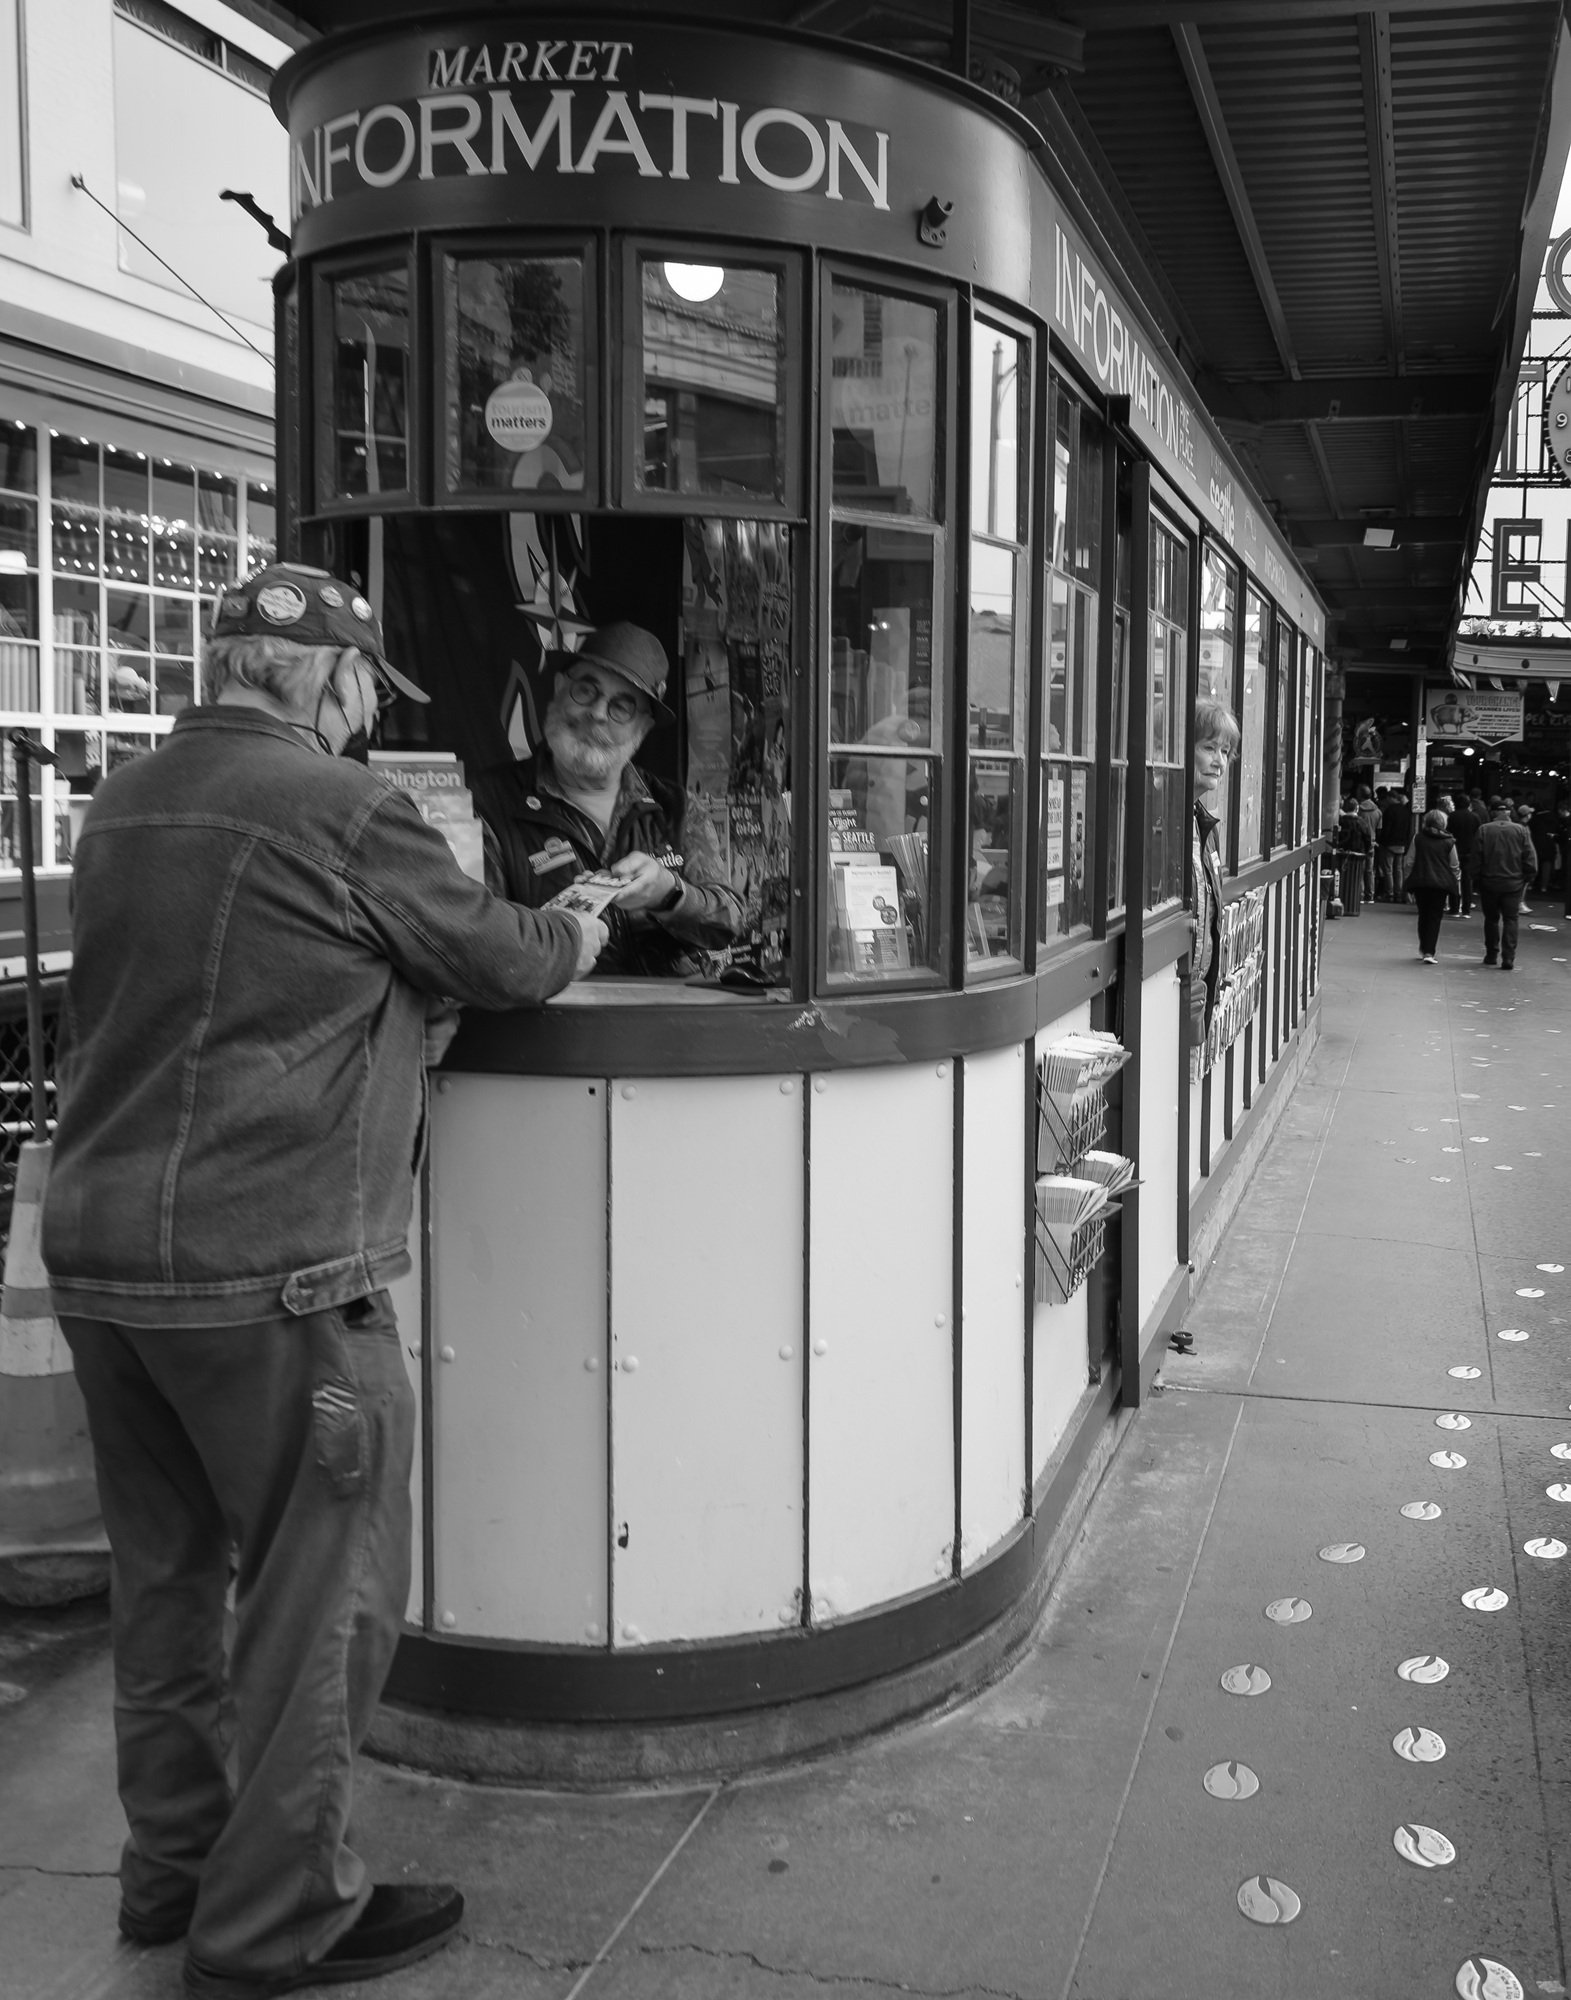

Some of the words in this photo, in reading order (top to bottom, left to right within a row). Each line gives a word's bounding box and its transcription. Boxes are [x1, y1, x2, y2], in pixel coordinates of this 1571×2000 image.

[429, 40, 633, 89] MARKET
[290, 90, 890, 211] INFORMATION
[1054, 223, 1179, 459] INFORMATION
[491, 416, 546, 429] matters
[1209, 477, 1235, 547] seattle
[377, 768, 461, 790] hington
[842, 831, 876, 845] SEATTLE
[650, 851, 684, 868] attle
